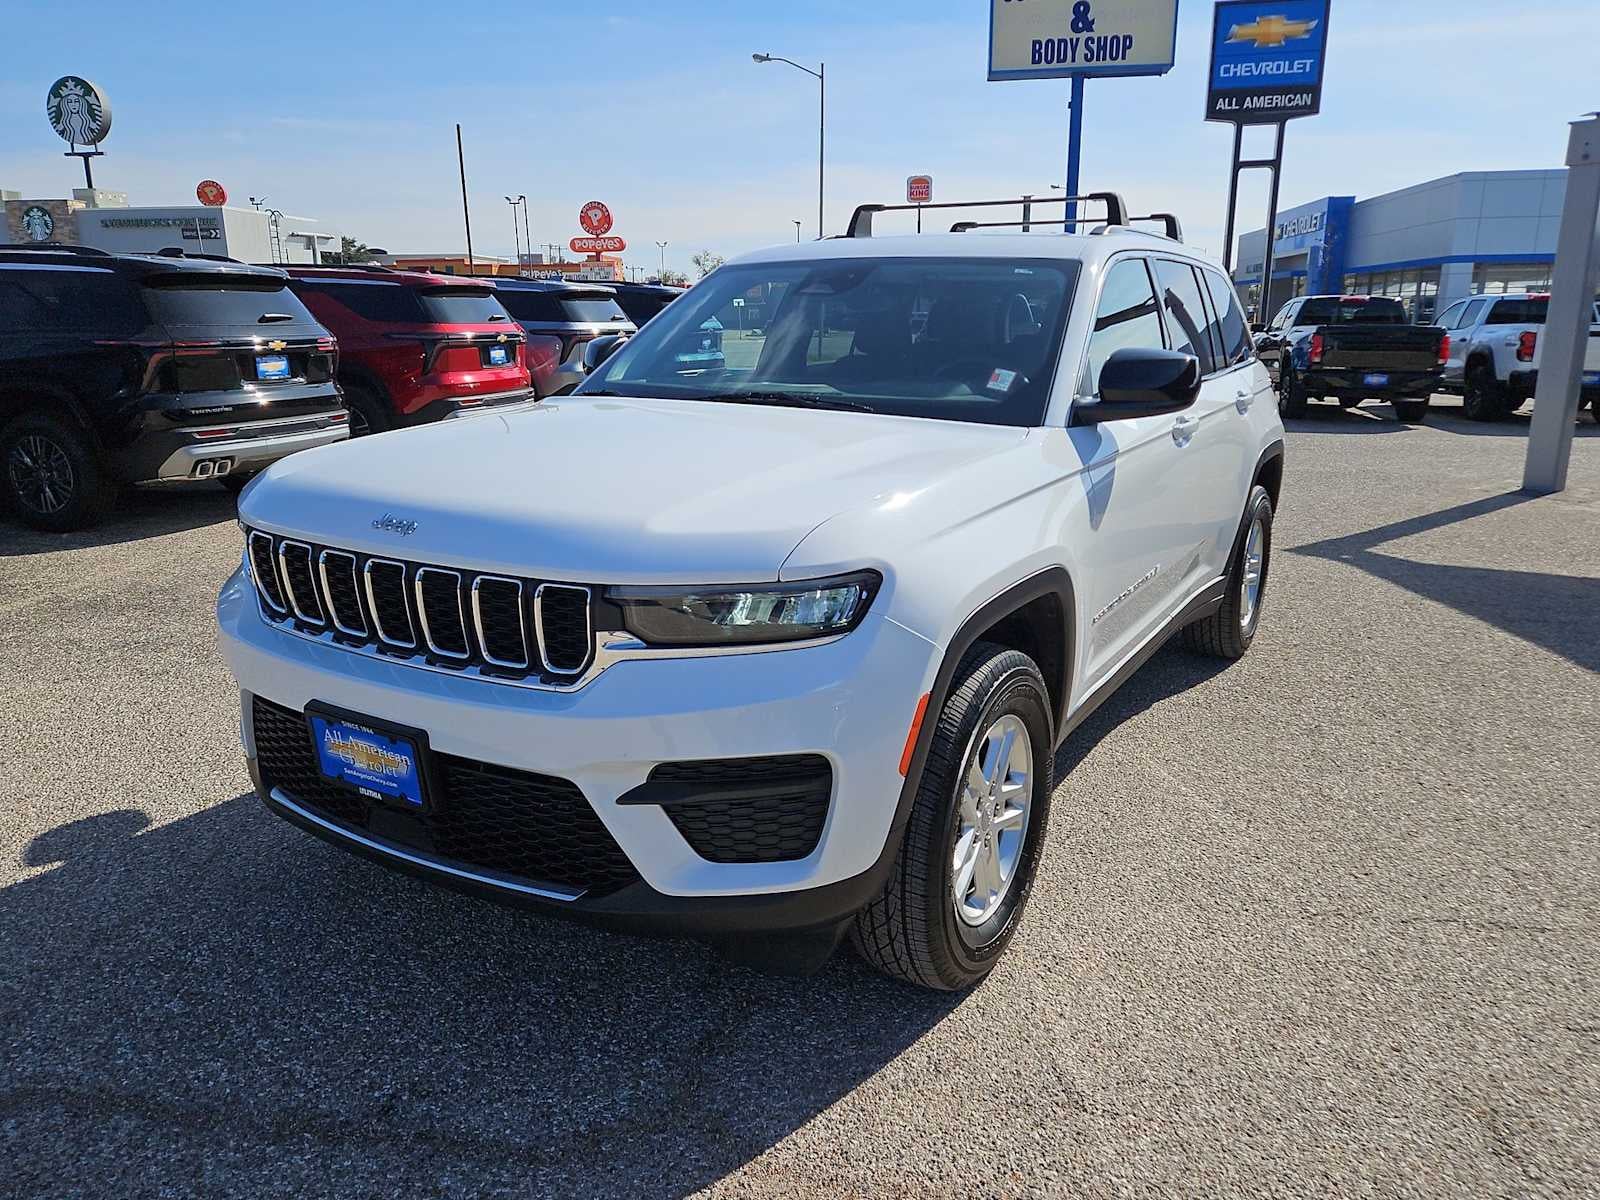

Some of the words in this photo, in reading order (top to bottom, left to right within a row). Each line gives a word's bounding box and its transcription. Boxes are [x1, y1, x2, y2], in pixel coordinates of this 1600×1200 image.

[1070, 0, 1096, 34] &
[1031, 37, 1080, 65] BODY
[1084, 34, 1133, 63] SHOP
[1219, 58, 1314, 78] CHEVROLET
[1216, 97, 1240, 110] ALL
[1243, 93, 1312, 109] AMERICAN
[1282, 212, 1322, 239] CHEVROLET
[371, 512, 419, 538] Jeep
[341, 720, 360, 731] SINCE
[323, 728, 343, 746] All
[347, 735, 411, 766] American
